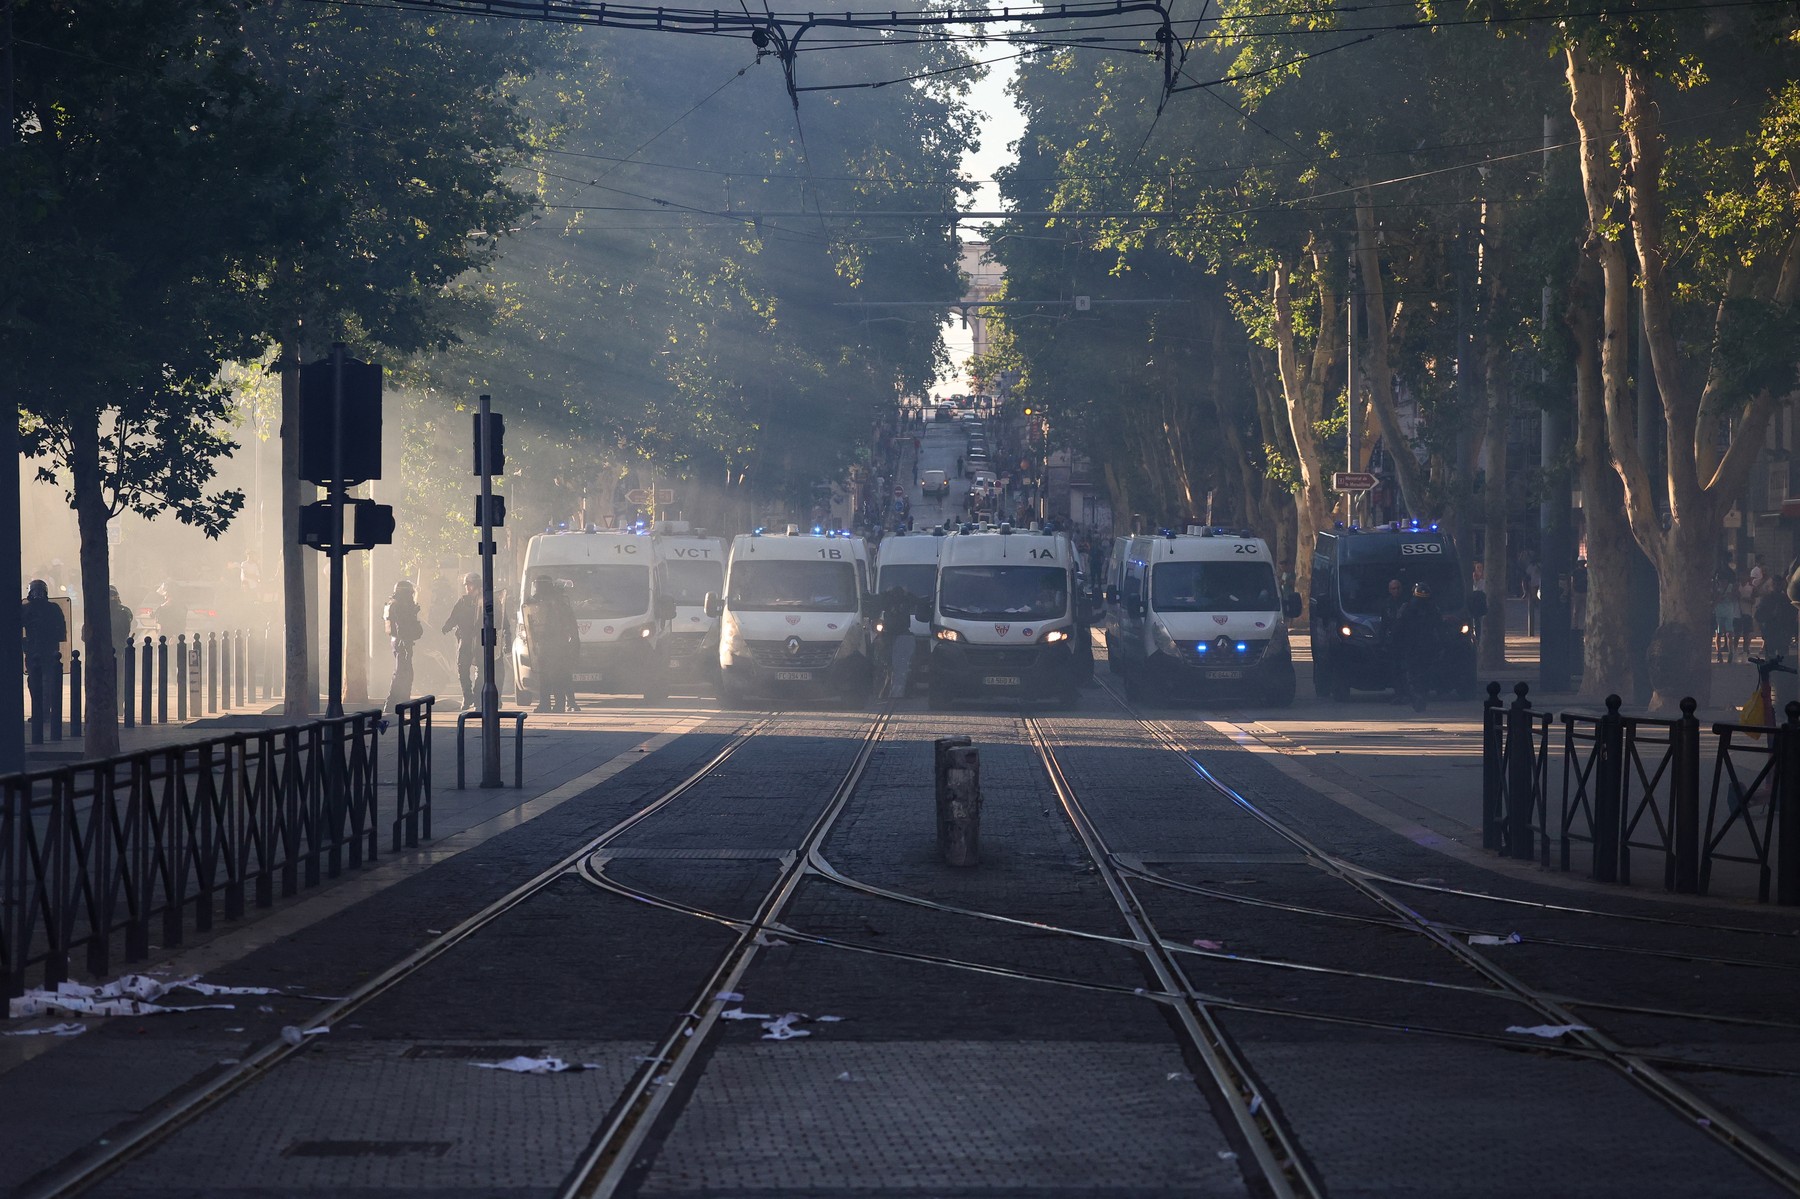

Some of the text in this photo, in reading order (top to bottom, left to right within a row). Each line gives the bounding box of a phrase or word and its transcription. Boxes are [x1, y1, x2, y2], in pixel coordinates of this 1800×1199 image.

[614, 544, 637, 554] 1C
[674, 548, 711, 558] VCT
[818, 548, 842, 559] 1B
[1029, 548, 1054, 559] 1A
[1233, 544, 1258, 554] 2C
[1402, 544, 1440, 554] SSO
